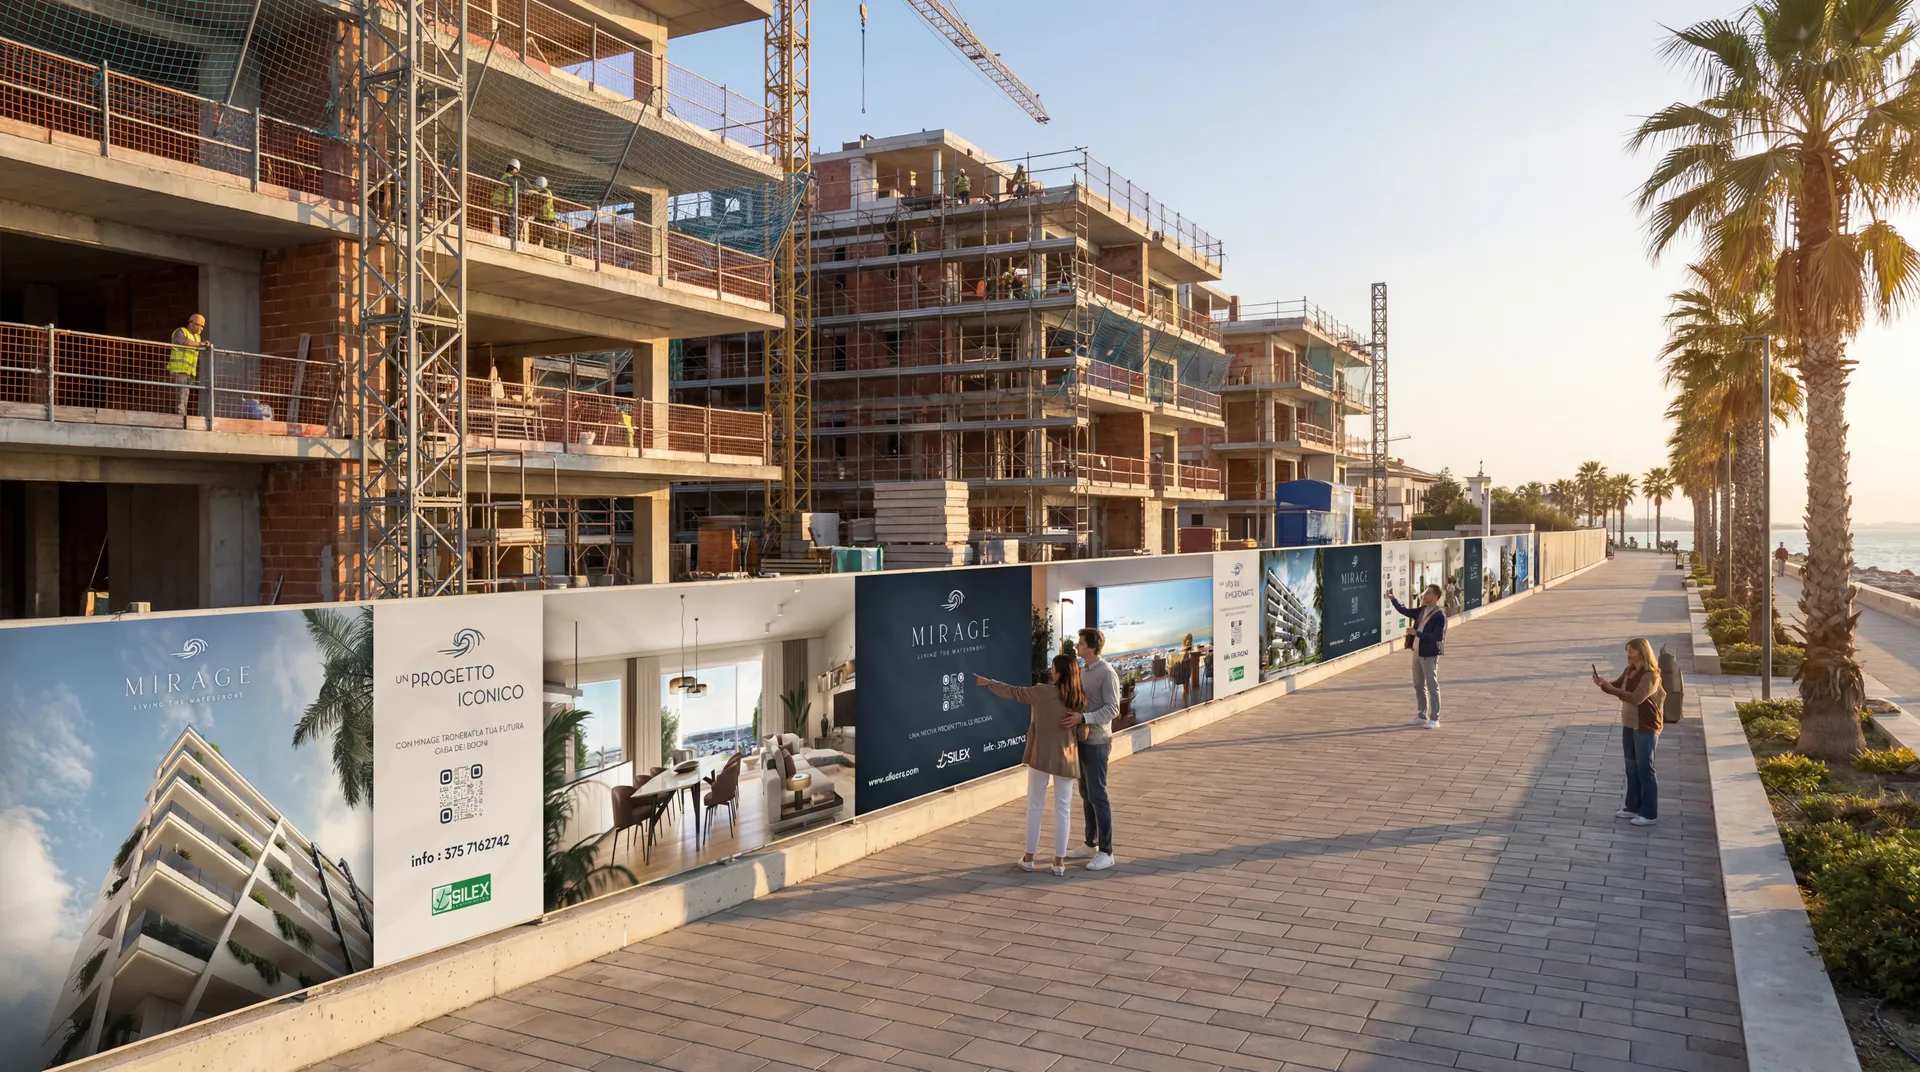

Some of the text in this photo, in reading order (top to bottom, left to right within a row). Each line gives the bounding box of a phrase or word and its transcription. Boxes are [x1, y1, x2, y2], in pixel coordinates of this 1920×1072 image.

[911, 618, 990, 647] MIRAGE
[125, 665, 251, 696] MIRAGE
[395, 664, 495, 688] UN PROGETTO
[133, 701, 165, 711] LIVING
[458, 684, 524, 707] ICONICO
[395, 740, 413, 750] CON
[485, 726, 498, 735] TUA
[499, 722, 525, 733] FUTURA
[947, 747, 971, 764] SILEX
[411, 851, 435, 868] info
[444, 844, 464, 860] 375
[466, 834, 510, 855] 7162742
[452, 881, 490, 905] SILEX
